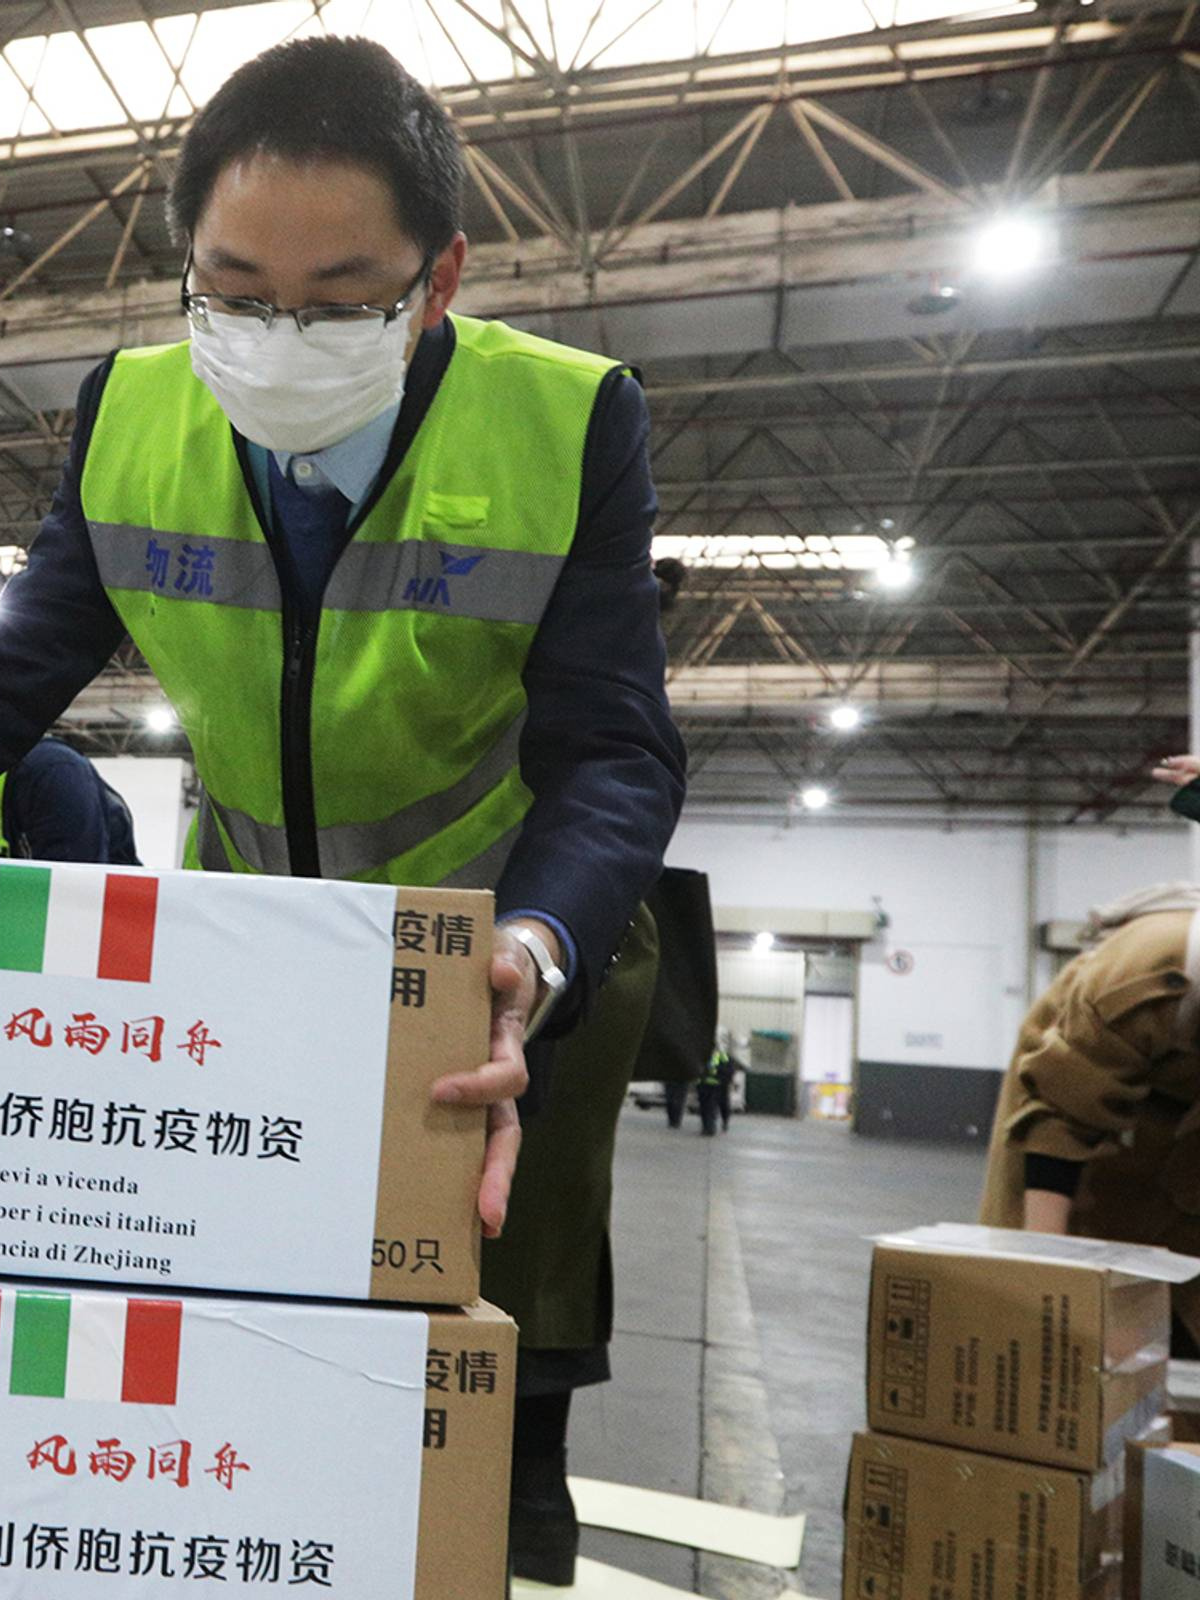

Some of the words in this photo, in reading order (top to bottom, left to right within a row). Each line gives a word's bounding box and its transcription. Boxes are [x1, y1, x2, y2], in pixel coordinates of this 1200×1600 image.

[392, 910, 474, 956] 疫情
[391, 967, 426, 1008] 用
[3, 1007, 222, 1067] 风雨同舟
[36, 1171, 48, 1187] a
[54, 1171, 139, 1195] vicenda
[36, 1204, 43, 1223] i
[49, 1207, 111, 1229] cinesi
[117, 1212, 197, 1237] italiani
[46, 1243, 67, 1262] di
[73, 1245, 172, 1275] Zhejiang
[26, 1434, 250, 1491] 风雨同舟
